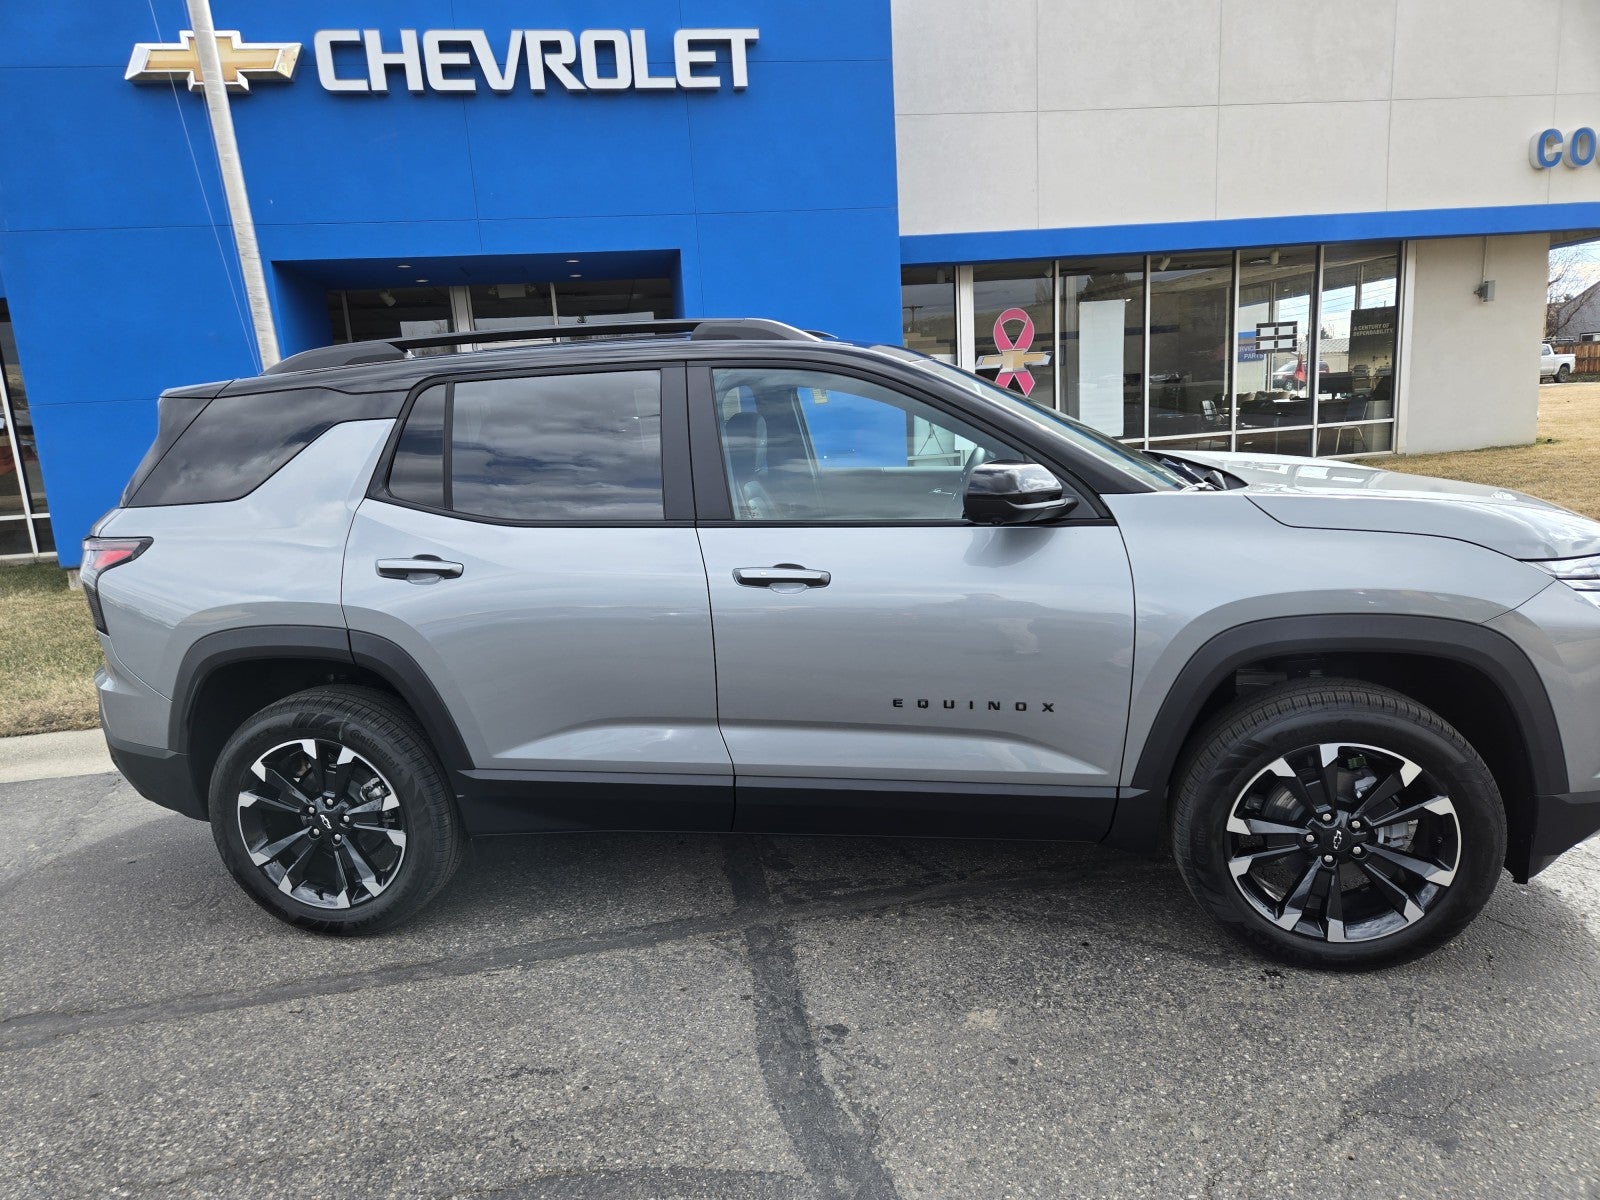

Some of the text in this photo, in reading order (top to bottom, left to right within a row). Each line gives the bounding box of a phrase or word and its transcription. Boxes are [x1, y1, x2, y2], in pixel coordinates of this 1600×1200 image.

[314, 28, 760, 93] CHEVROLET
[1530, 127, 1600, 169] CO
[1359, 323, 1382, 331] CENTURY
[1243, 352, 1264, 360] PARTS
[892, 698, 1055, 712] EQUINOX
